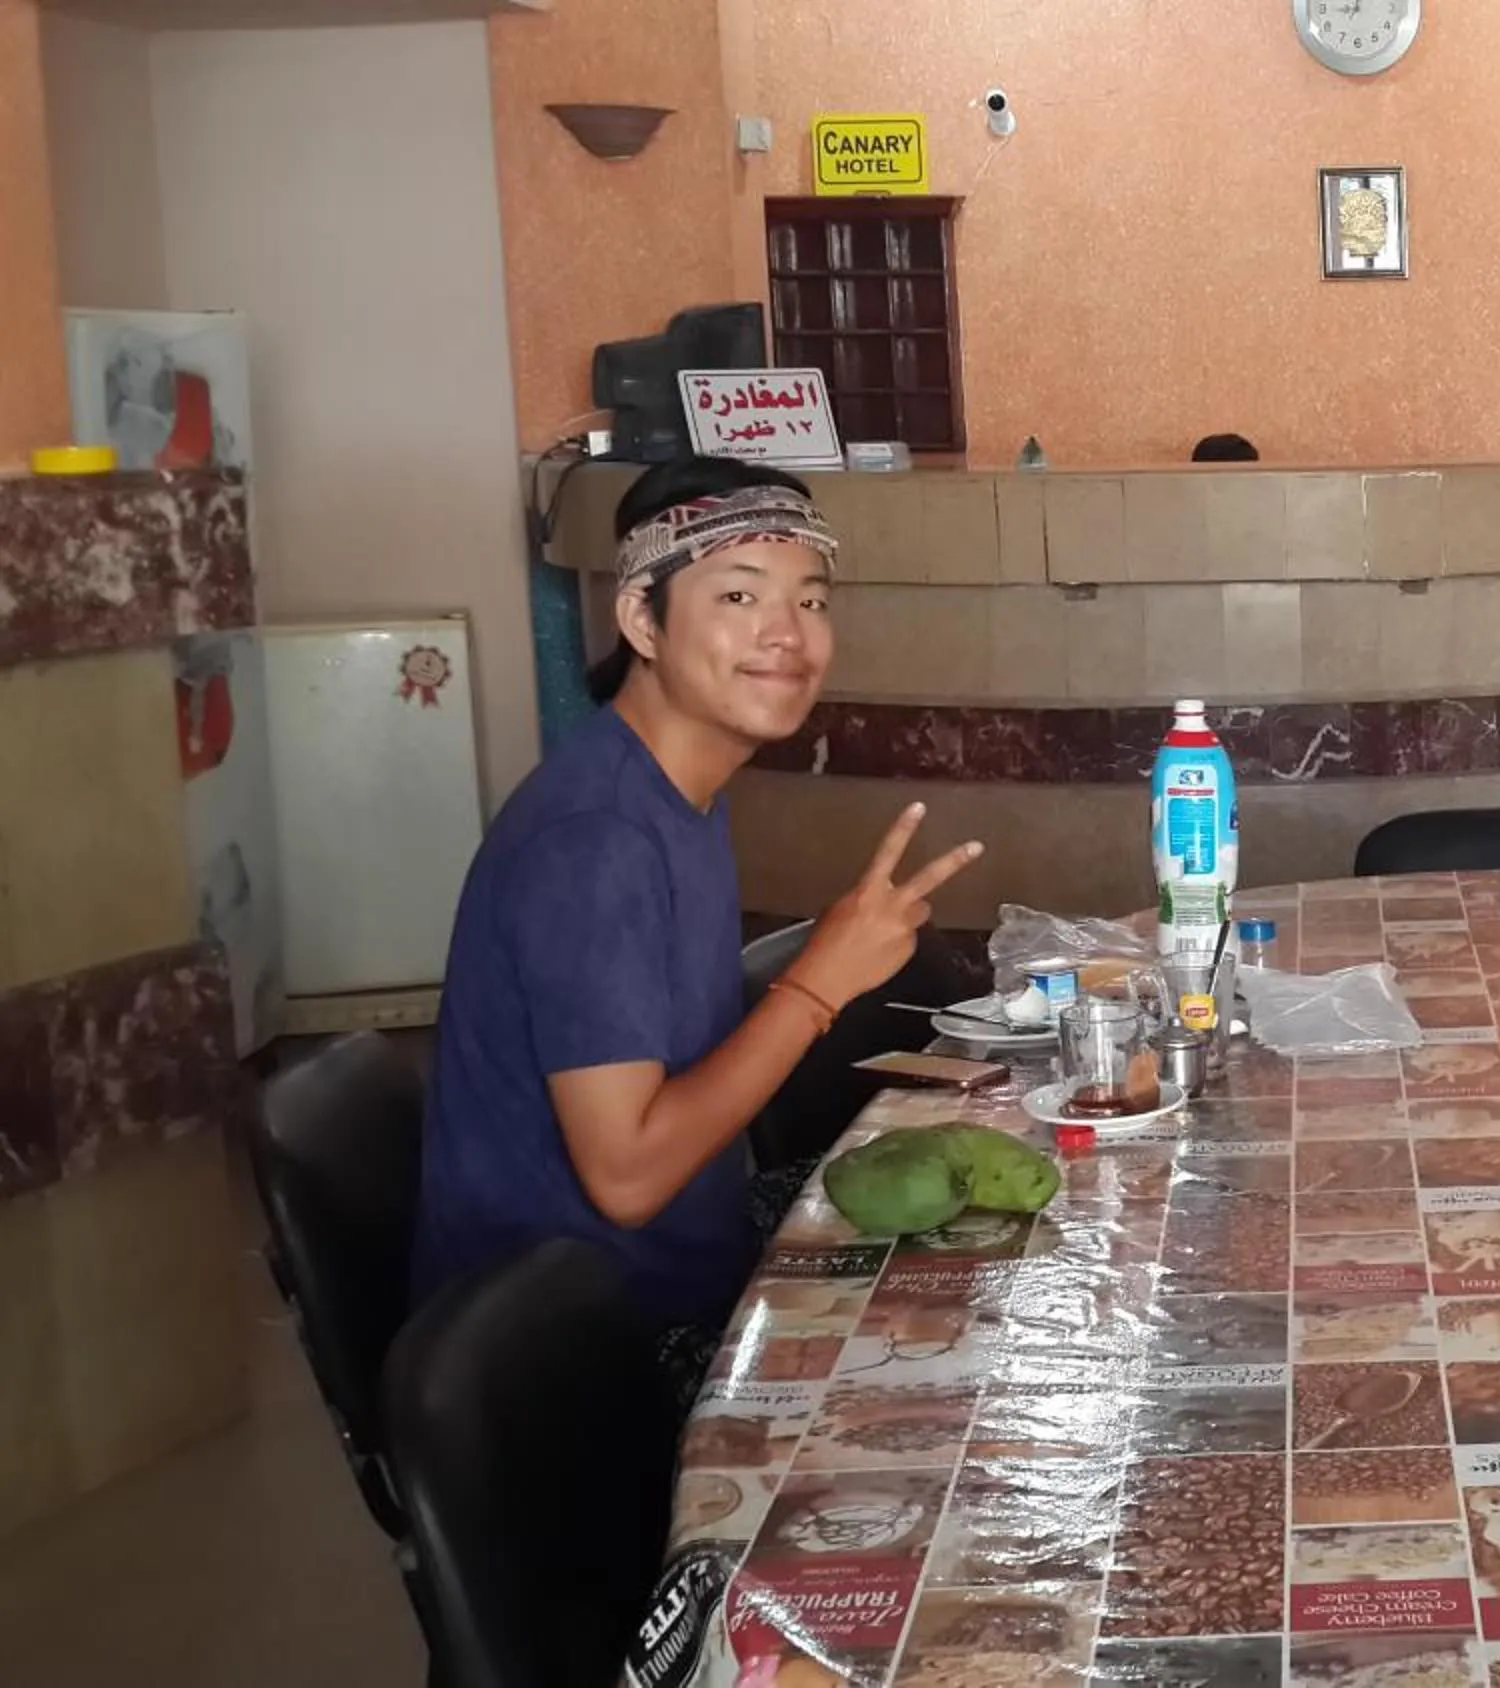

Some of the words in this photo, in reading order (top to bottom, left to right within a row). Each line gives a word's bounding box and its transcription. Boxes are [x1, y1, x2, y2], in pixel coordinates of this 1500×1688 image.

[823, 130, 913, 155] CANARY
[835, 158, 901, 174] HOTEL
[693, 378, 818, 417] المغادرة
[714, 419, 776, 442] ظهرا
[1317, 1591, 1369, 1605] Cake
[1376, 1588, 1441, 1601] Coffee
[638, 1558, 710, 1651] LATTE
[1303, 1602, 1379, 1615] Cheese
[1385, 1599, 1457, 1612] Cream
[819, 1605, 903, 1628] Java
[1327, 1612, 1433, 1627] Blueberry
